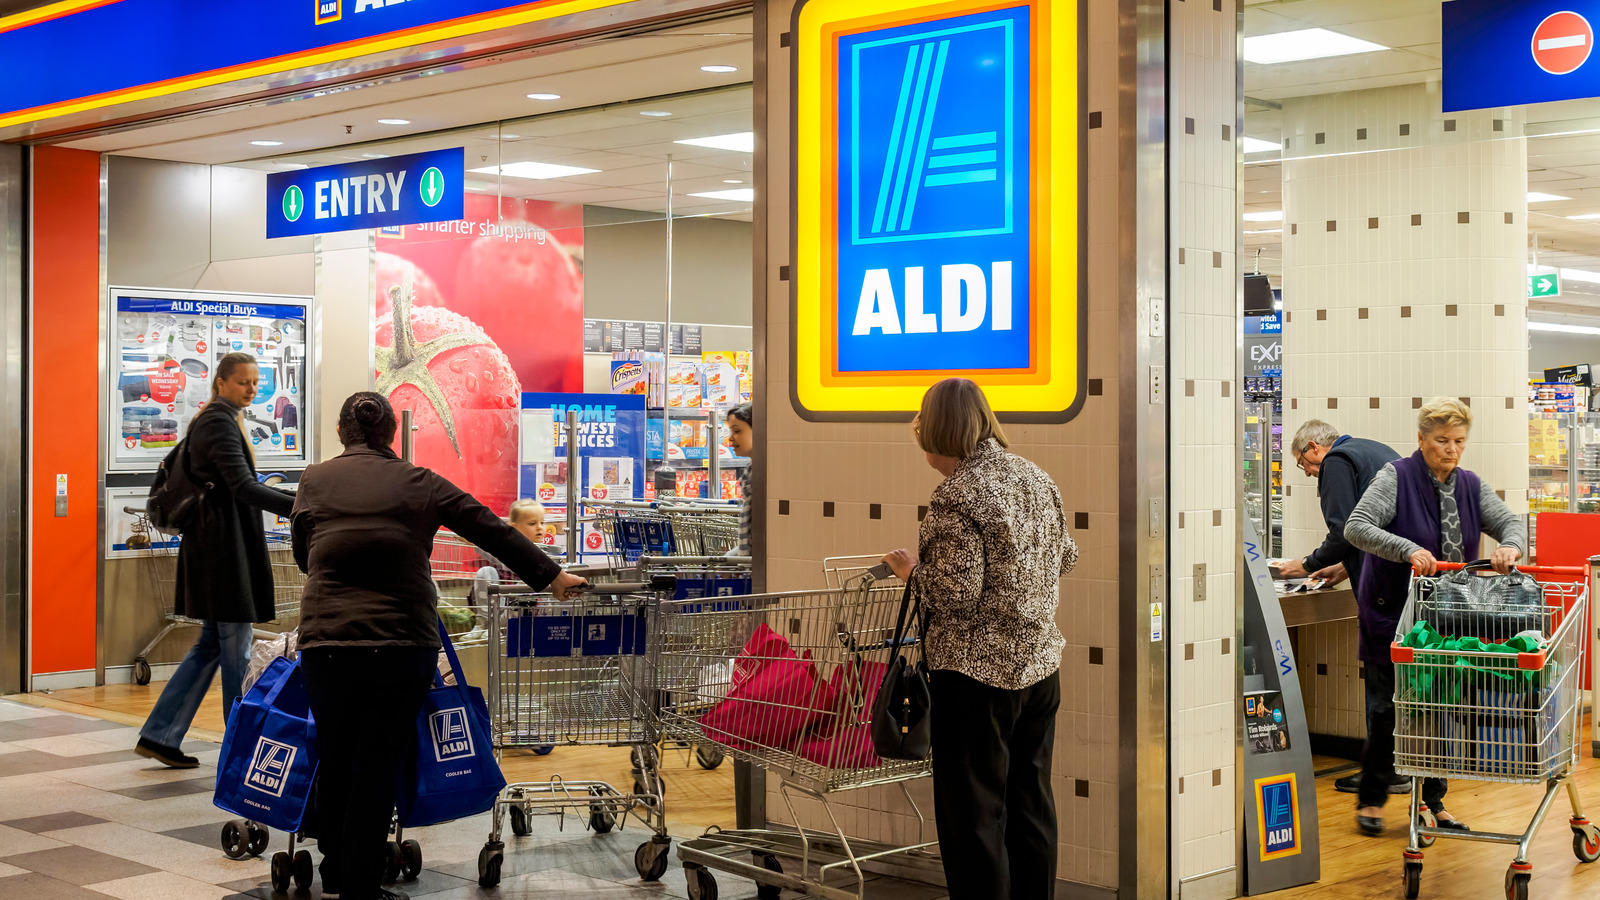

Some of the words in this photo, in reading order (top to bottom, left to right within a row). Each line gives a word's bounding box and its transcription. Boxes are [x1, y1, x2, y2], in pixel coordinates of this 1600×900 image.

[320, 2, 337, 15] ALDI
[314, 170, 407, 220] ENTRY
[479, 218, 547, 246] shopping
[851, 260, 1013, 336] ALDI
[171, 301, 194, 312] ALDI
[195, 302, 231, 316] Special
[233, 304, 258, 317] Buys
[1265, 322, 1281, 330] Save
[550, 403, 617, 423] HOME
[559, 422, 617, 435] LWEST
[441, 741, 469, 756] ALDI
[250, 771, 280, 790] ALDI
[243, 798, 261, 809] COOLER
[1267, 827, 1293, 846] ALDI
